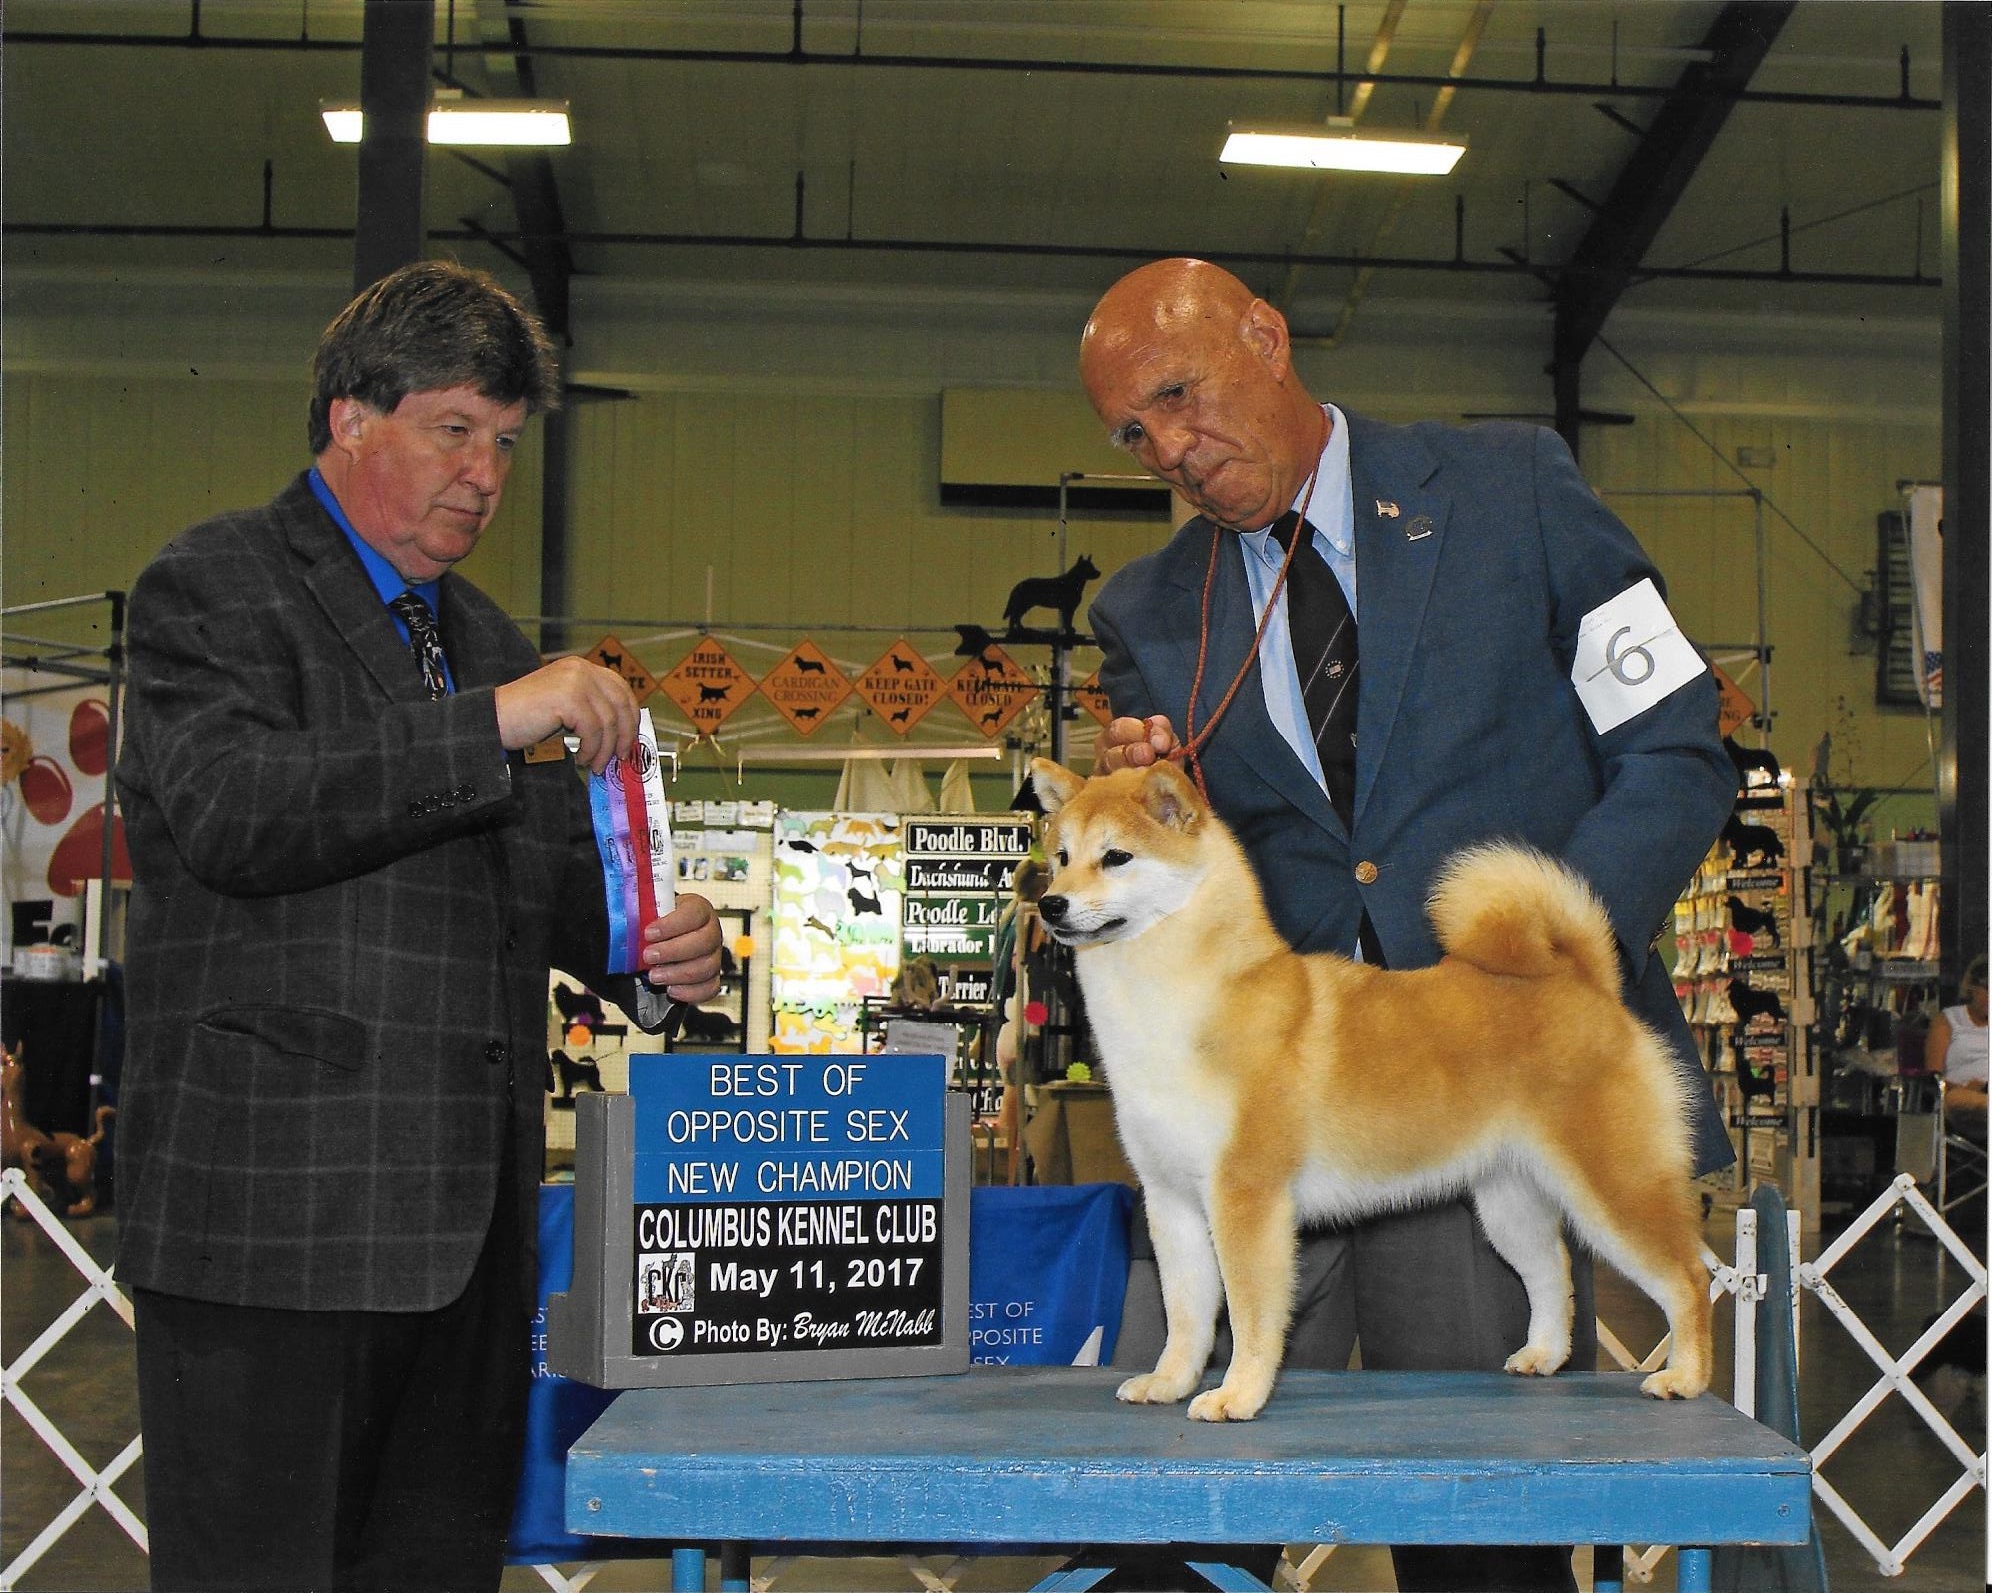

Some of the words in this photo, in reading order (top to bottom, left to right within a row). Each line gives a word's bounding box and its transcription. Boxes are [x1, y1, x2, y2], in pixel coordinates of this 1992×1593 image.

[692, 653, 726, 666] IRISH
[1606, 626, 1655, 686] 6
[685, 666, 733, 679] SETTER
[771, 677, 840, 689] CARDIGAN
[865, 678, 899, 691] KEEP
[904, 679, 937, 692] GATE
[774, 690, 838, 702] CROSSING
[872, 691, 929, 706] CLOSED!
[692, 707, 722, 720] XING
[915, 827, 975, 852] Poodle
[980, 827, 1024, 852] Blvd.
[907, 899, 969, 925] Poodle
[938, 974, 988, 1001] Trrier
[711, 1064, 803, 1096] BEST
[822, 1063, 867, 1095] OF
[667, 1109, 830, 1143] OPPOSITE
[845, 1109, 910, 1141] SEX
[668, 1162, 740, 1194] NEW
[756, 1160, 913, 1193] CHAMPION
[639, 1206, 770, 1249] COLUMBUS
[778, 1205, 870, 1245] KENNEL
[876, 1204, 937, 1243] CLUB
[710, 1262, 779, 1298] May
[789, 1261, 837, 1293] 11,
[847, 1257, 924, 1288] 2017
[1005, 1302, 1034, 1318] OF
[693, 1319, 750, 1344] Photo
[756, 1318, 788, 1348] By:
[793, 1311, 851, 1347] Bryan
[854, 1308, 934, 1340] McNabb
